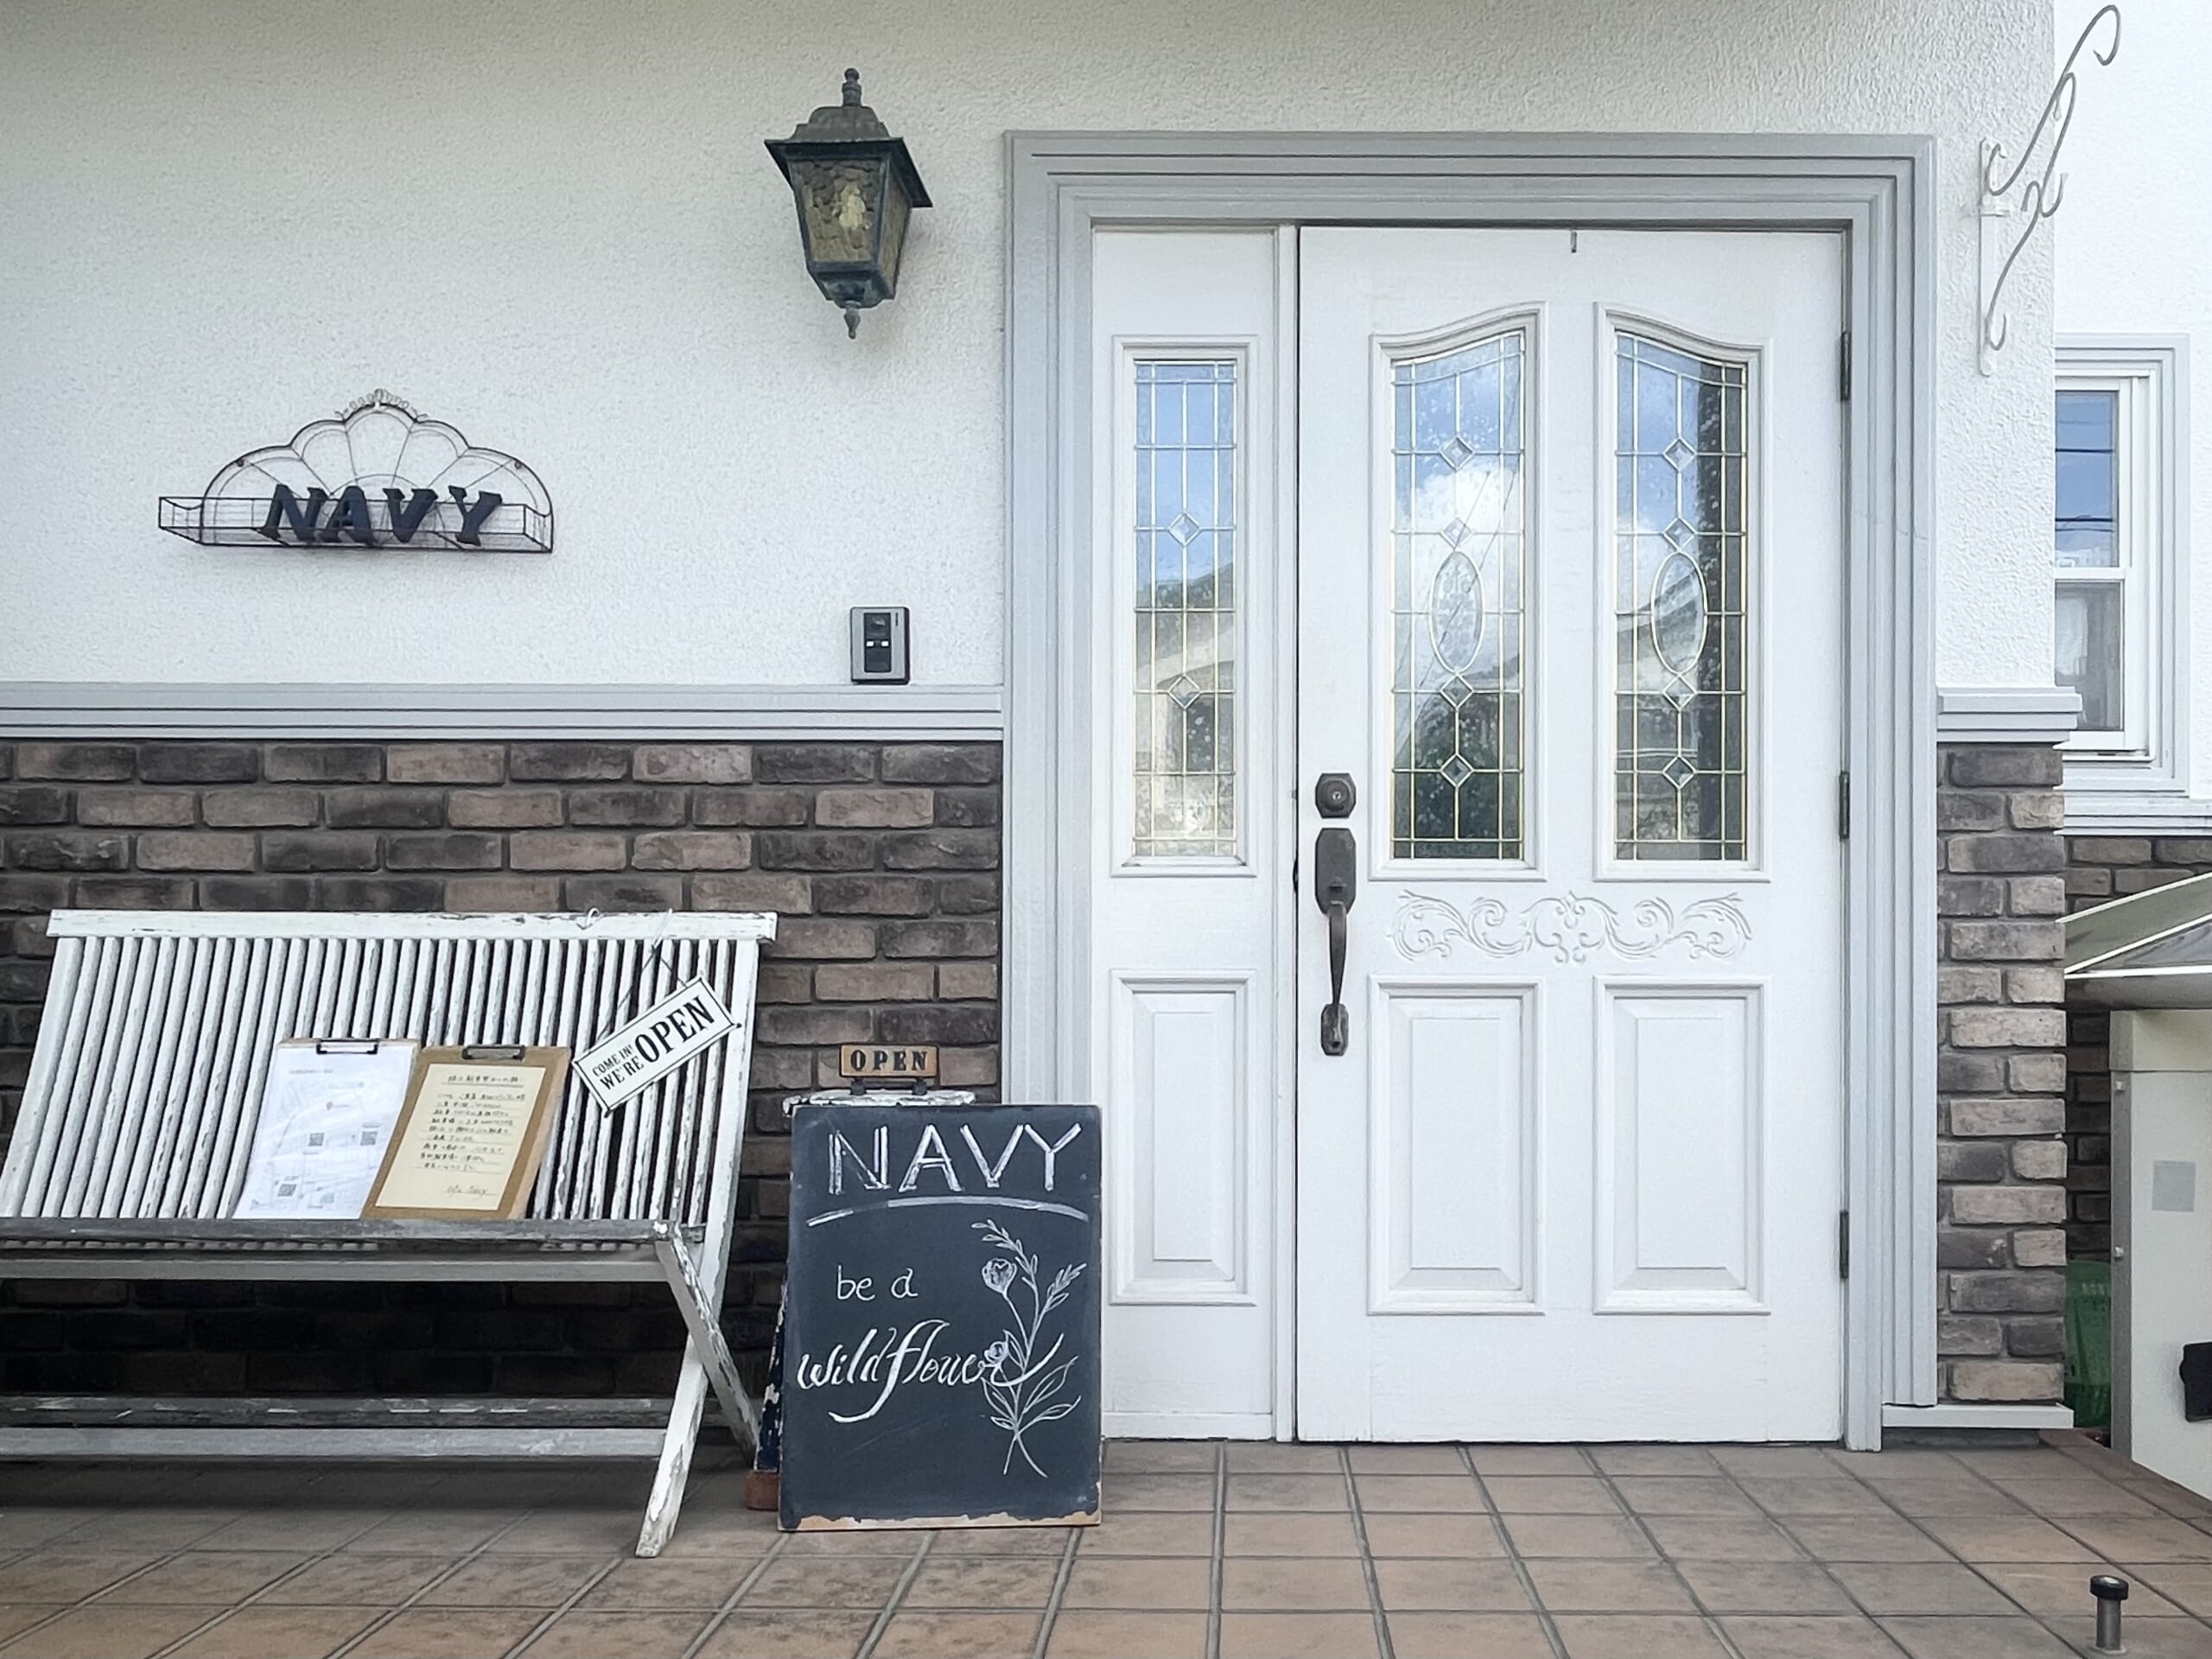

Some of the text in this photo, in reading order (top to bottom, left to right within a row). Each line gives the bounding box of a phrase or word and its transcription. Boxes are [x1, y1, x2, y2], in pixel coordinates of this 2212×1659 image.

[257, 484, 502, 546] NAVY
[634, 995, 715, 1063] OPEN
[592, 1053, 621, 1077] COME
[600, 1055, 645, 1090] WE'RE
[849, 1048, 929, 1071] OPEN
[828, 1123, 1082, 1196] NAVY
[836, 1264, 875, 1300] be
